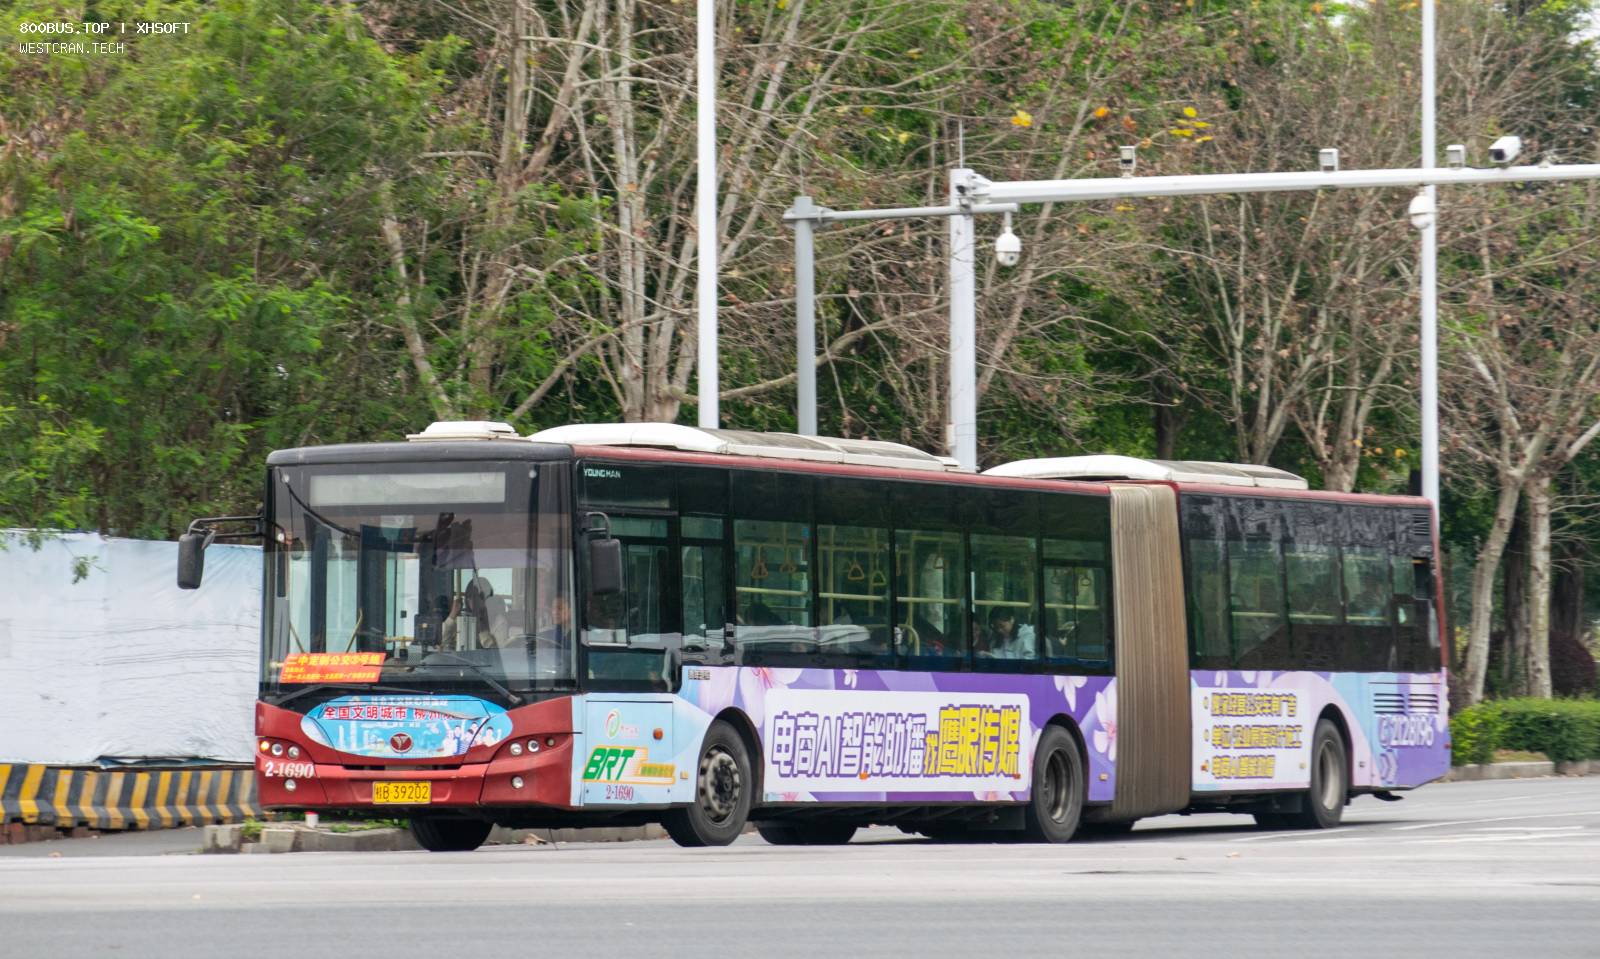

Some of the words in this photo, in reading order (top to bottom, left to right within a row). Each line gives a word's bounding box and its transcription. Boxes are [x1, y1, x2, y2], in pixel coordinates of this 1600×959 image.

[583, 468, 621, 478] YOUNGMAN
[323, 706, 407, 720] 全国文明城市
[264, 761, 315, 779] 2-1690
[582, 747, 636, 781] BRT
[606, 784, 634, 801] 2-1690
